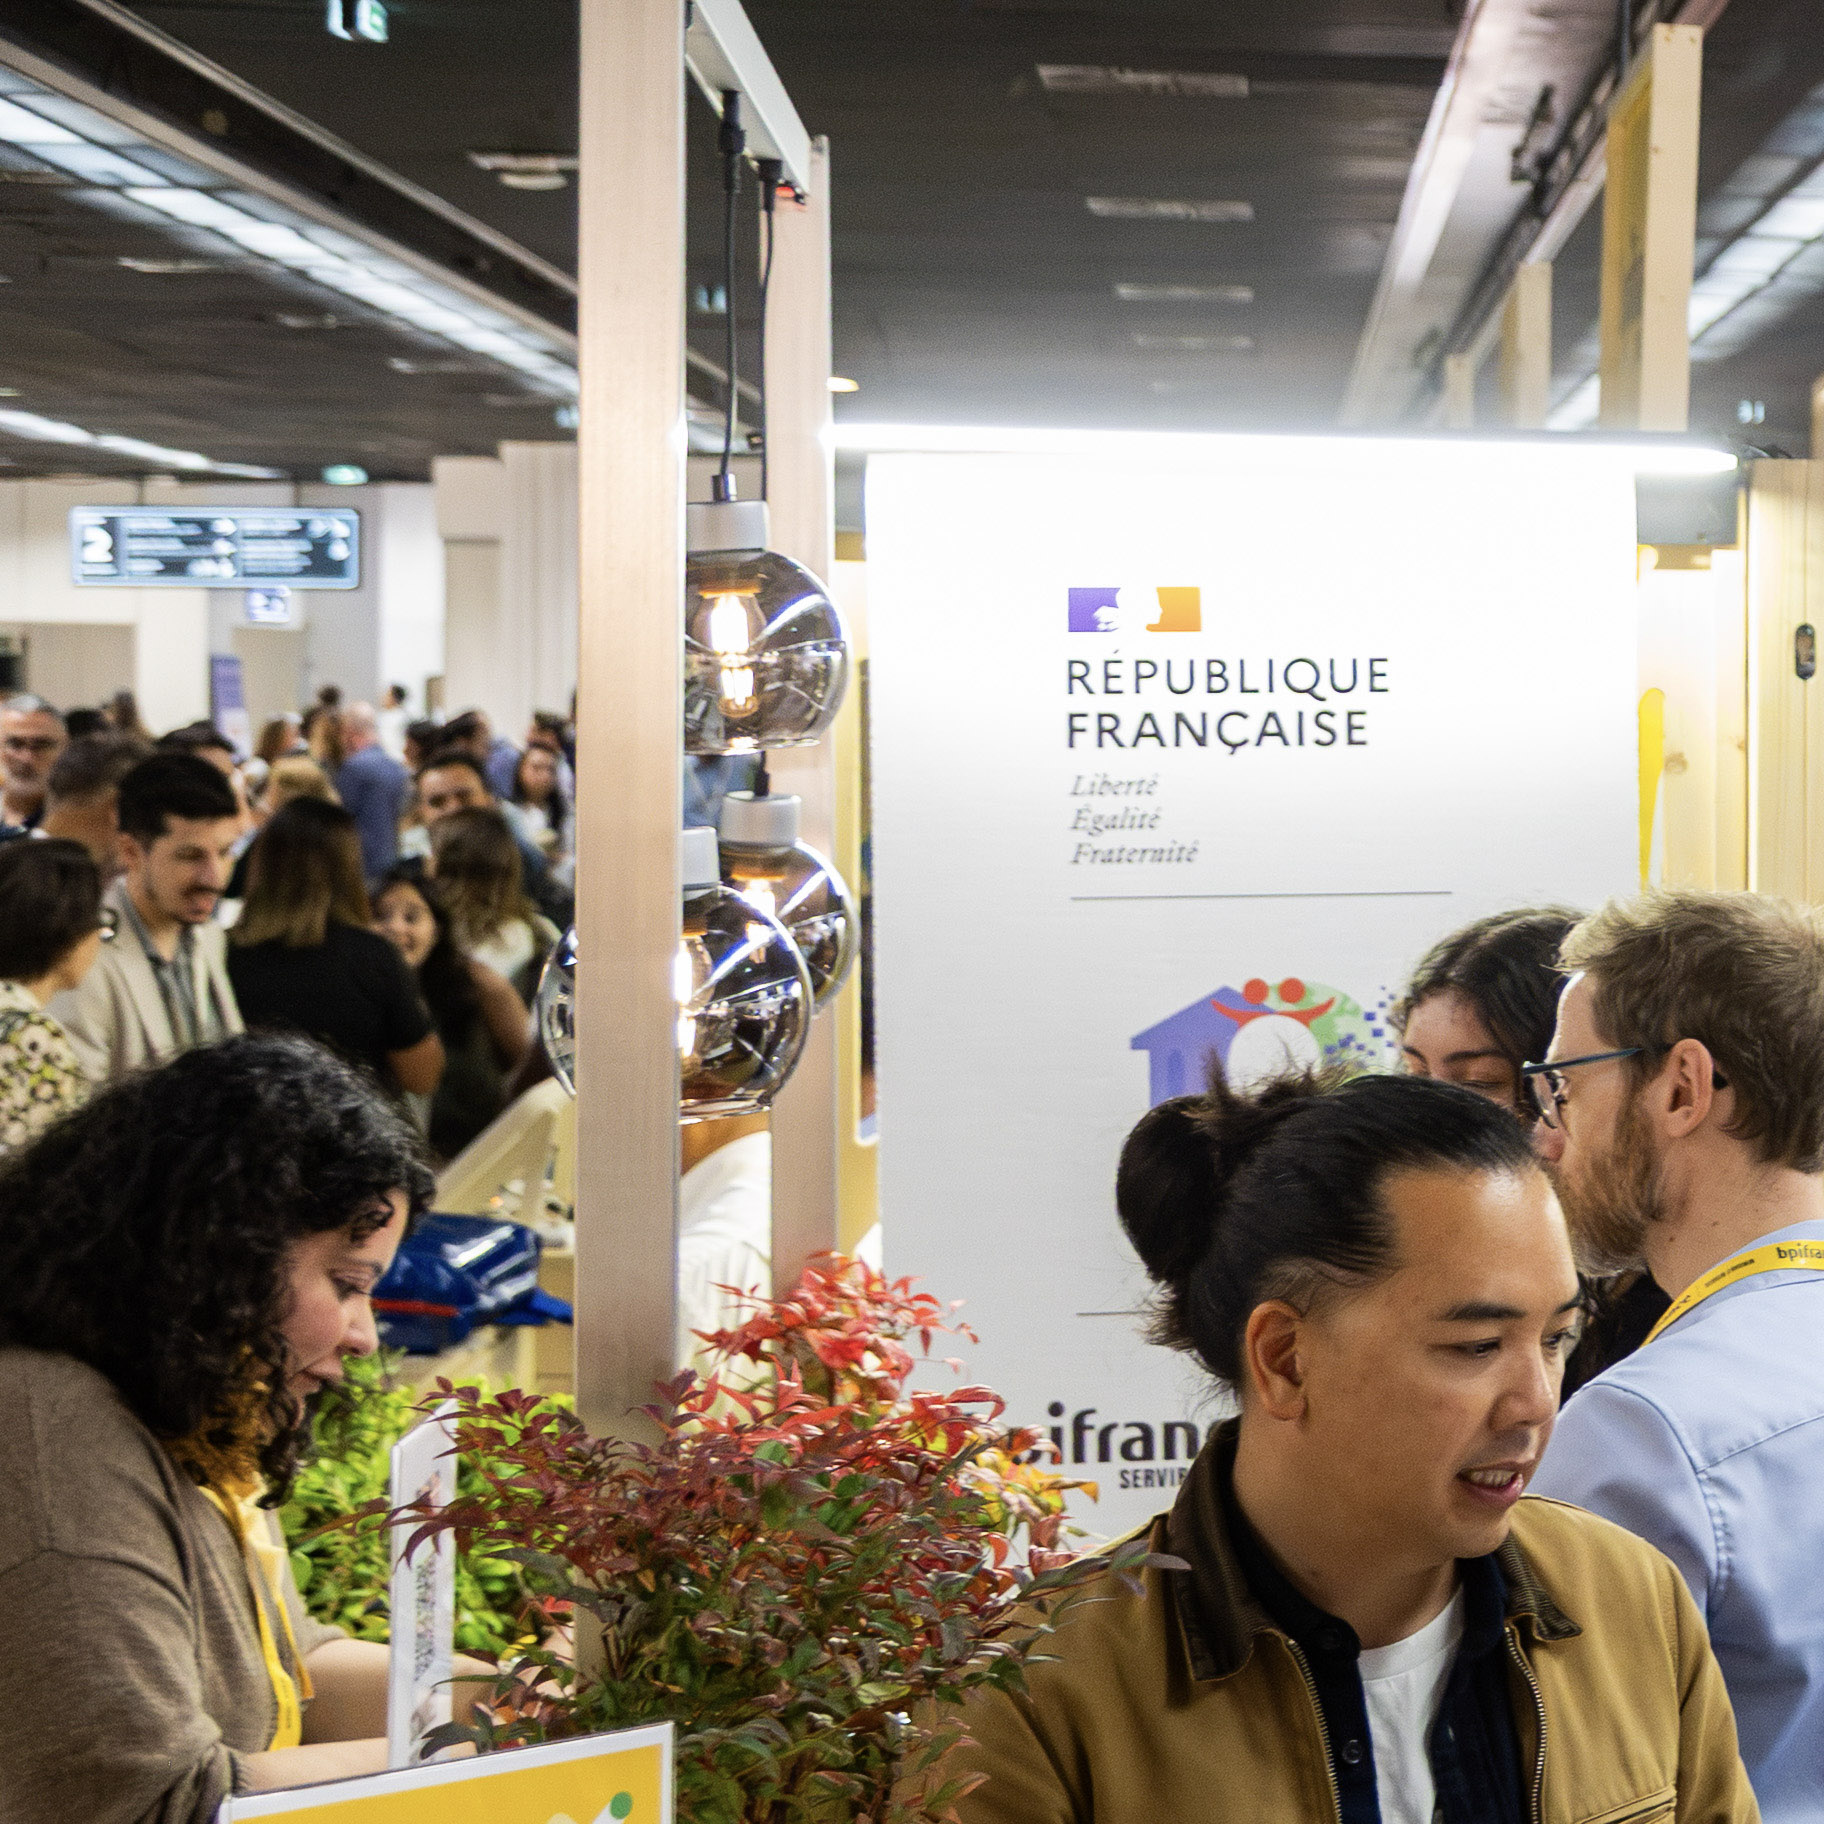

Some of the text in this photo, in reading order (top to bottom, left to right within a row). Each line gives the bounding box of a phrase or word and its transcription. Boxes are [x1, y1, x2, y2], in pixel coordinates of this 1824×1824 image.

[1067, 649, 1389, 702] RÉPUBLIQUE
[1068, 711, 1368, 755] FRANÇAISE
[1069, 771, 1160, 797] Liberté
[1070, 803, 1163, 837] Égalité
[1069, 839, 1200, 865] Fraternité
